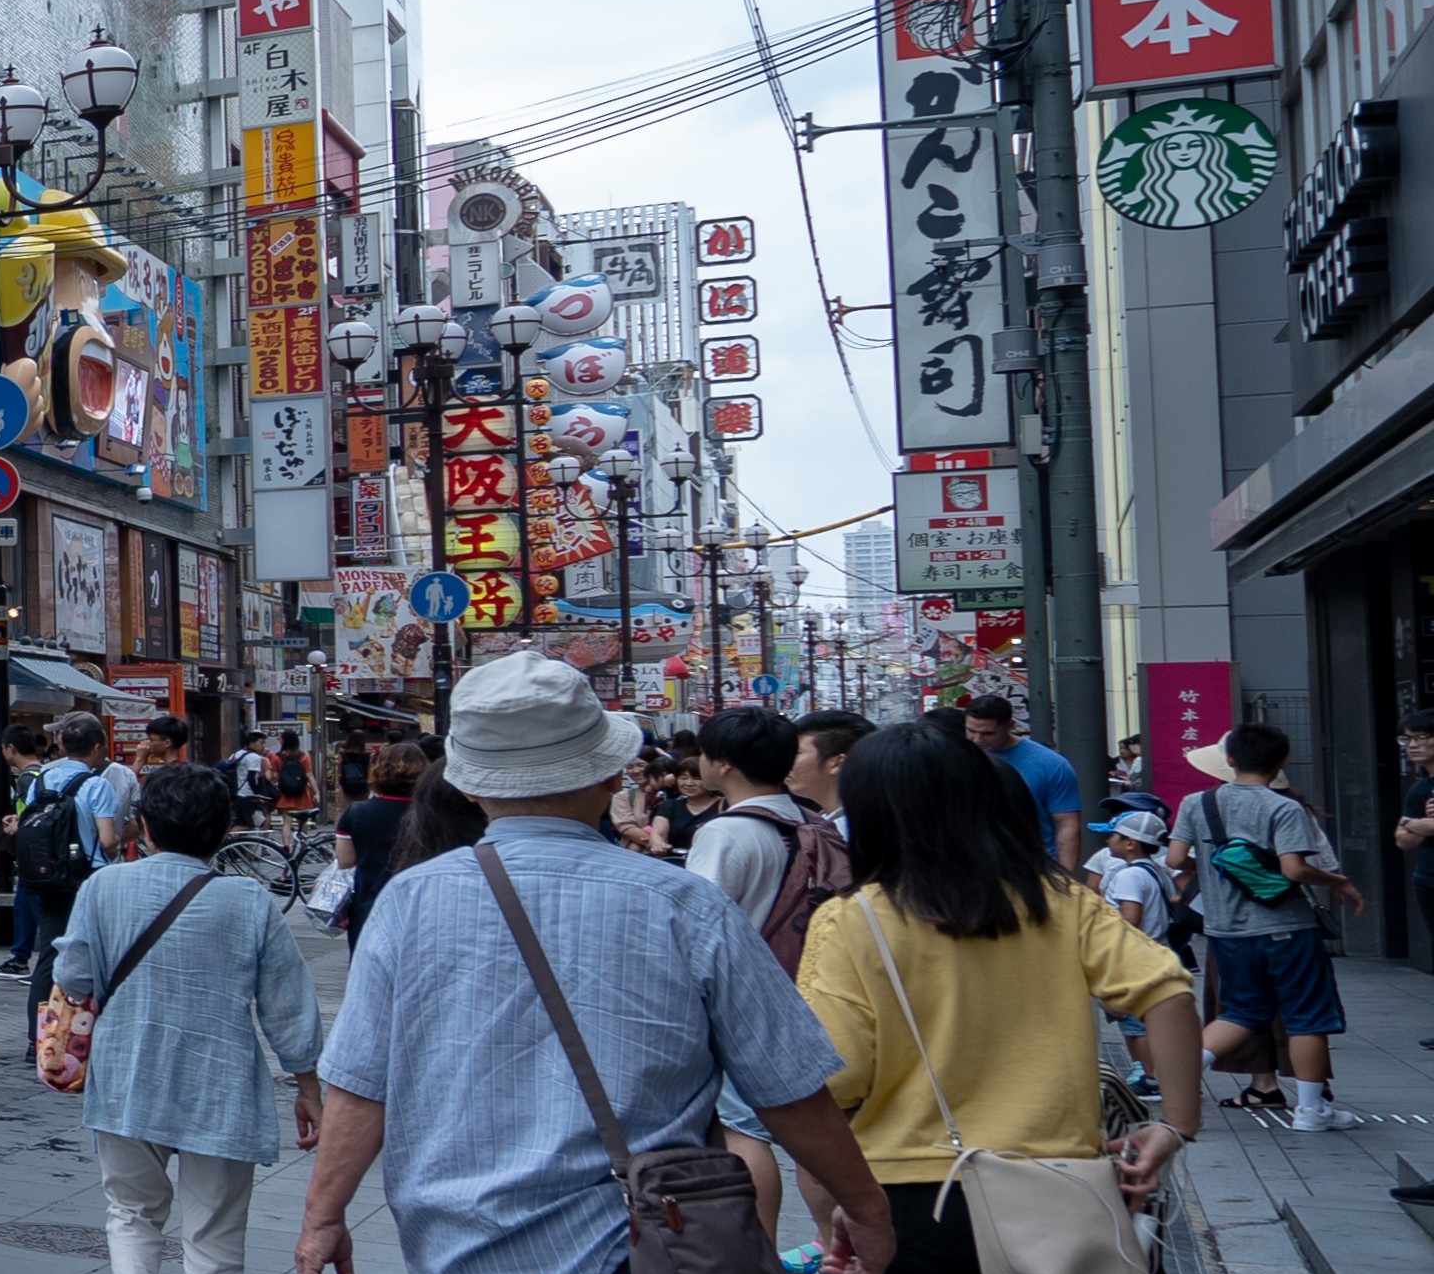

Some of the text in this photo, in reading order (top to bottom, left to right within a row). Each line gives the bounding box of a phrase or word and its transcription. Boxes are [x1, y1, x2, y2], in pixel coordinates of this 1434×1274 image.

[244, 43, 261, 56] 4F
[266, 43, 309, 118] 白木屋
[468, 205, 497, 223] NK
[1300, 223, 1354, 343] COFFEE
[298, 306, 318, 316] 2F
[338, 570, 407, 583] MONSTER
[961, 592, 1024, 603] 個室・和
[340, 663, 358, 674] 2F
